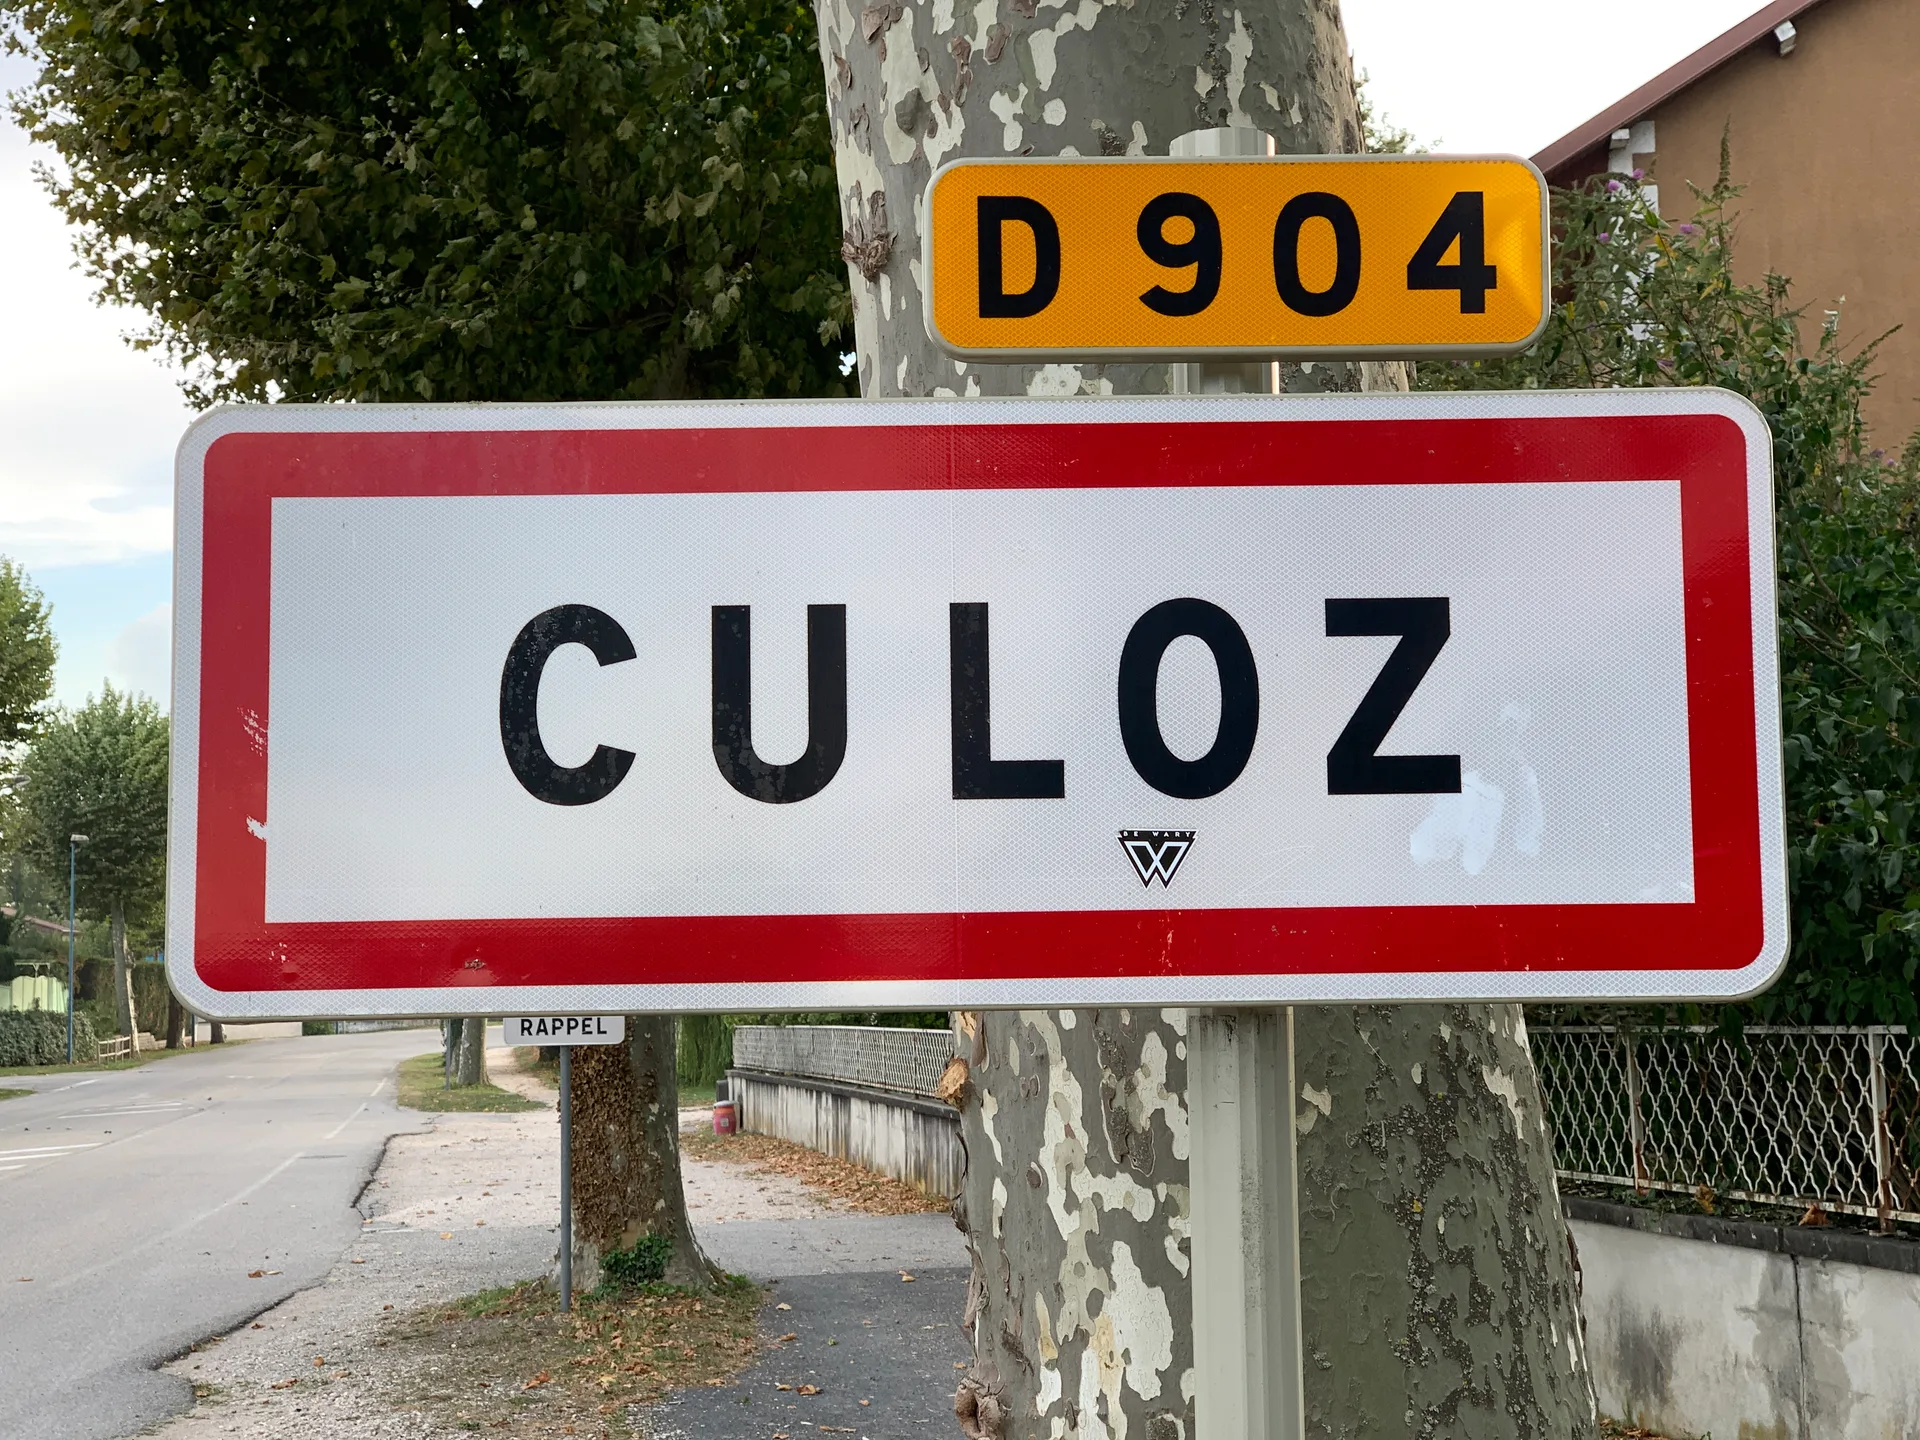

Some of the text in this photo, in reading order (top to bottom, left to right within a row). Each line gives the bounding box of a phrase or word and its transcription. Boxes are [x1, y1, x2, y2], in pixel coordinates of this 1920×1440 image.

[977, 191, 1498, 319] D 904
[500, 597, 1462, 806] CULOZ
[1151, 830, 1191, 838] WARY
[520, 1017, 608, 1036] RAPPEL
